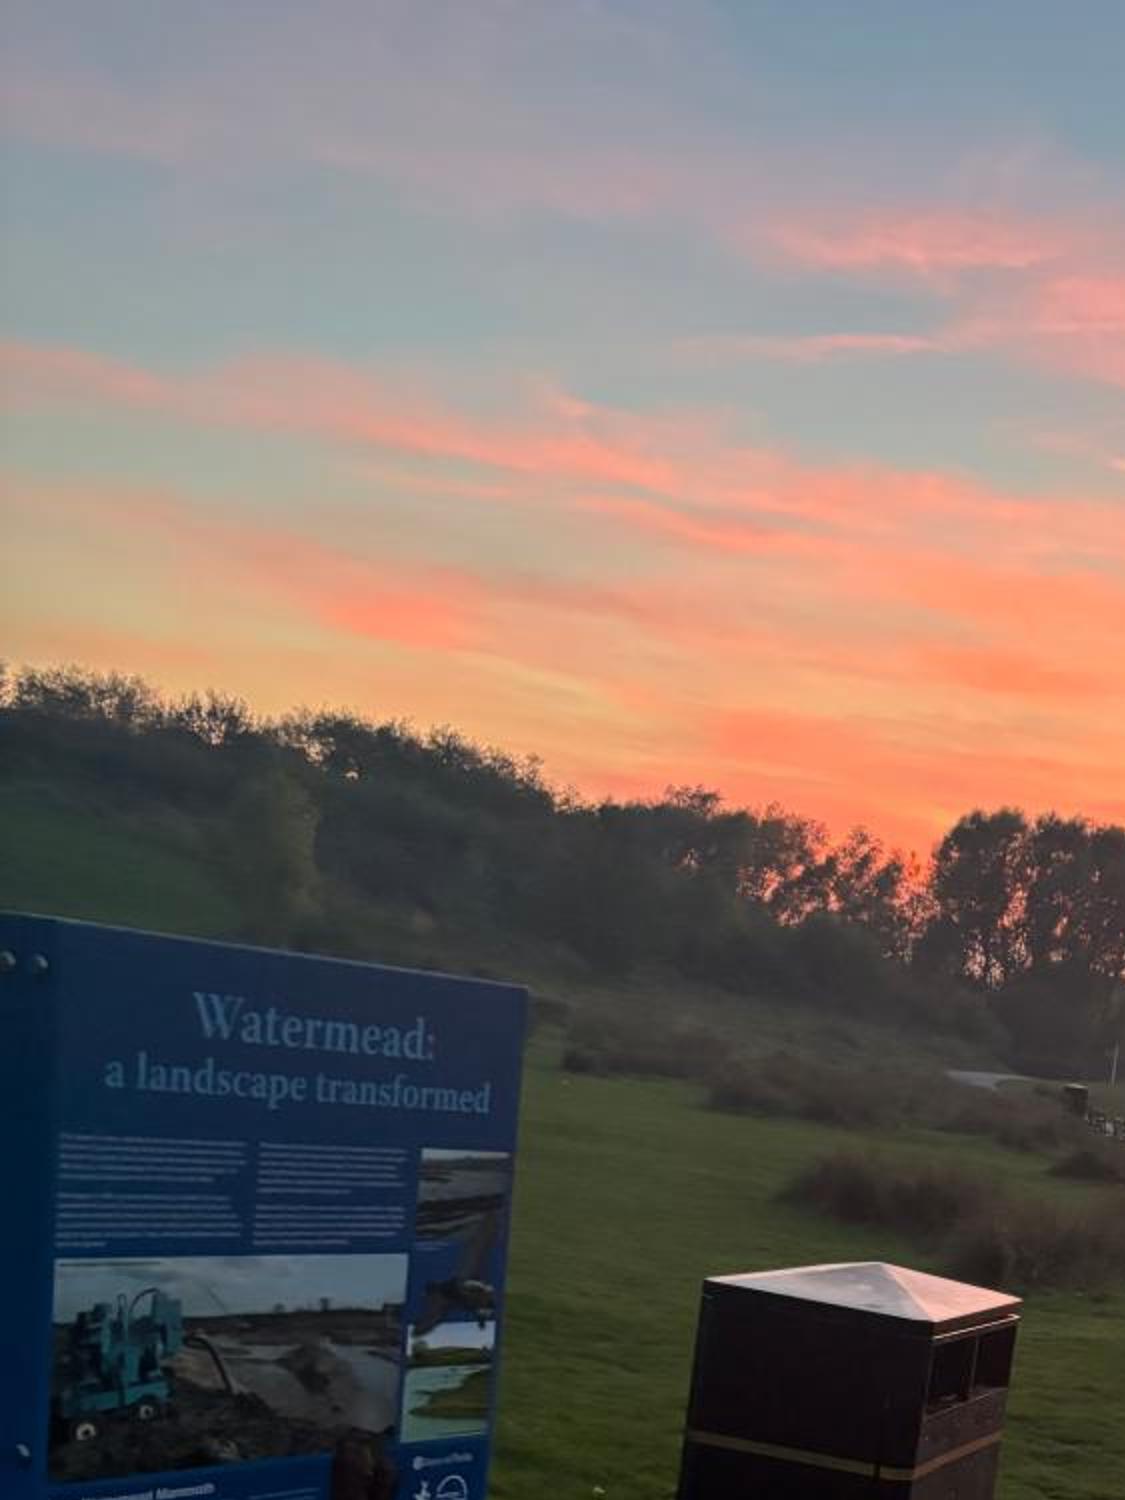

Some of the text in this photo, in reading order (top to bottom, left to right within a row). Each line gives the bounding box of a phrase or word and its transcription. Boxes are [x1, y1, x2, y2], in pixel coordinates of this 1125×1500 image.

[193, 991, 435, 1061] Watermead:
[104, 1051, 492, 1115] a landscape transformed
